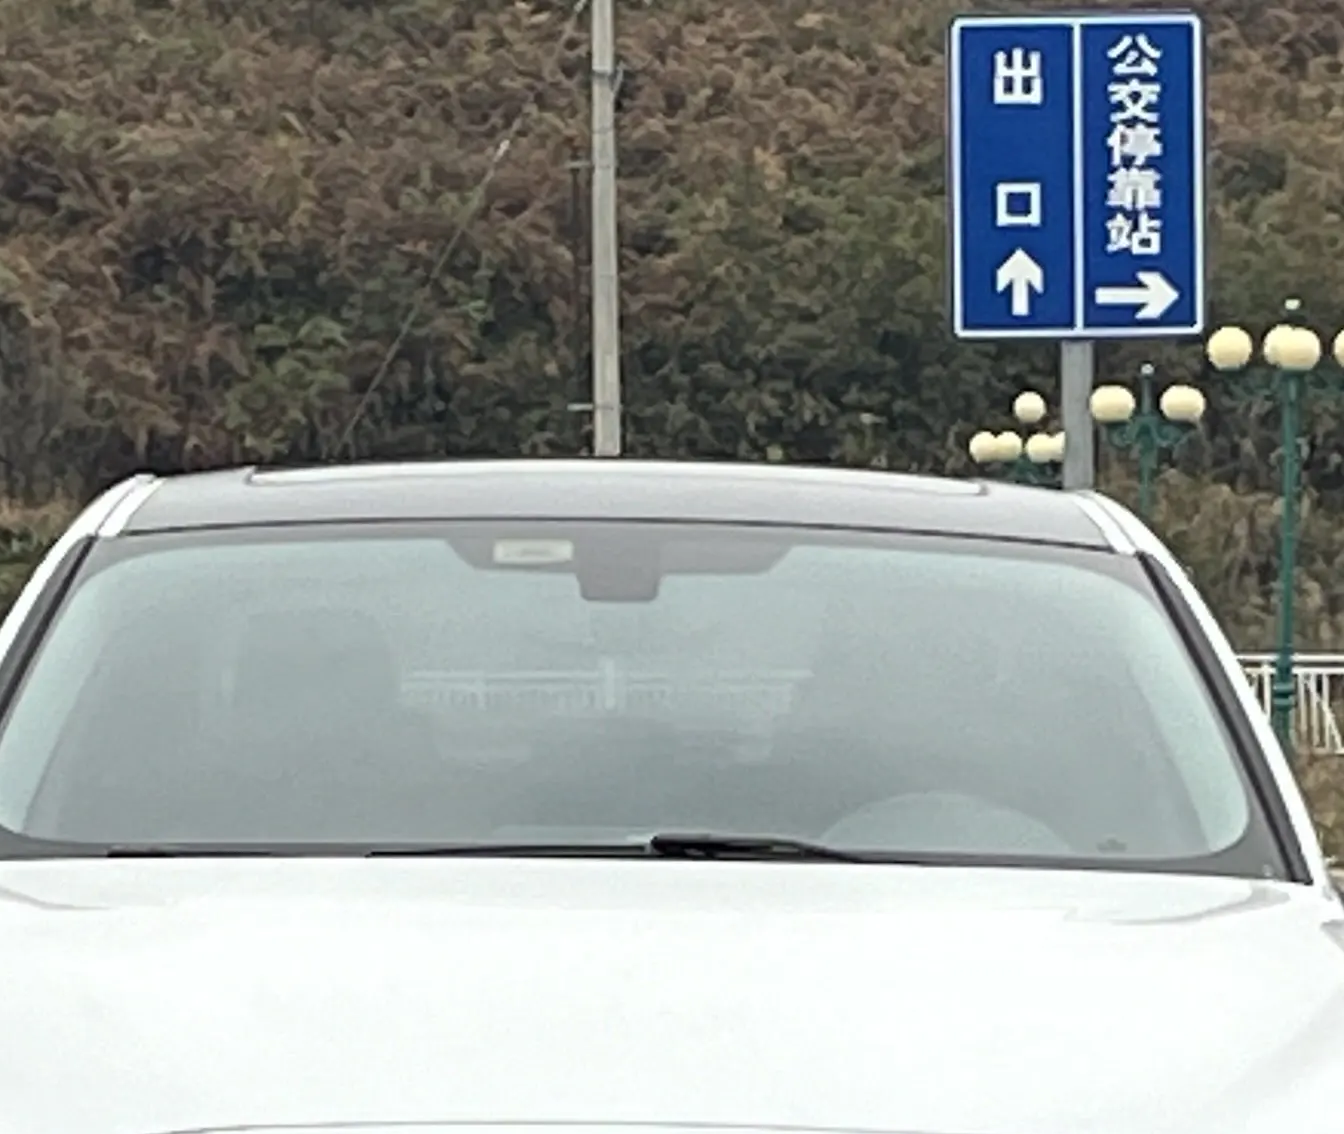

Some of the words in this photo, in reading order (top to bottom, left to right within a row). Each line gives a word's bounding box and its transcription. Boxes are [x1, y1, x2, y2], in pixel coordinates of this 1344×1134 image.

[993, 47, 1043, 227] 出口
[1106, 33, 1162, 255] 公交停靠站
